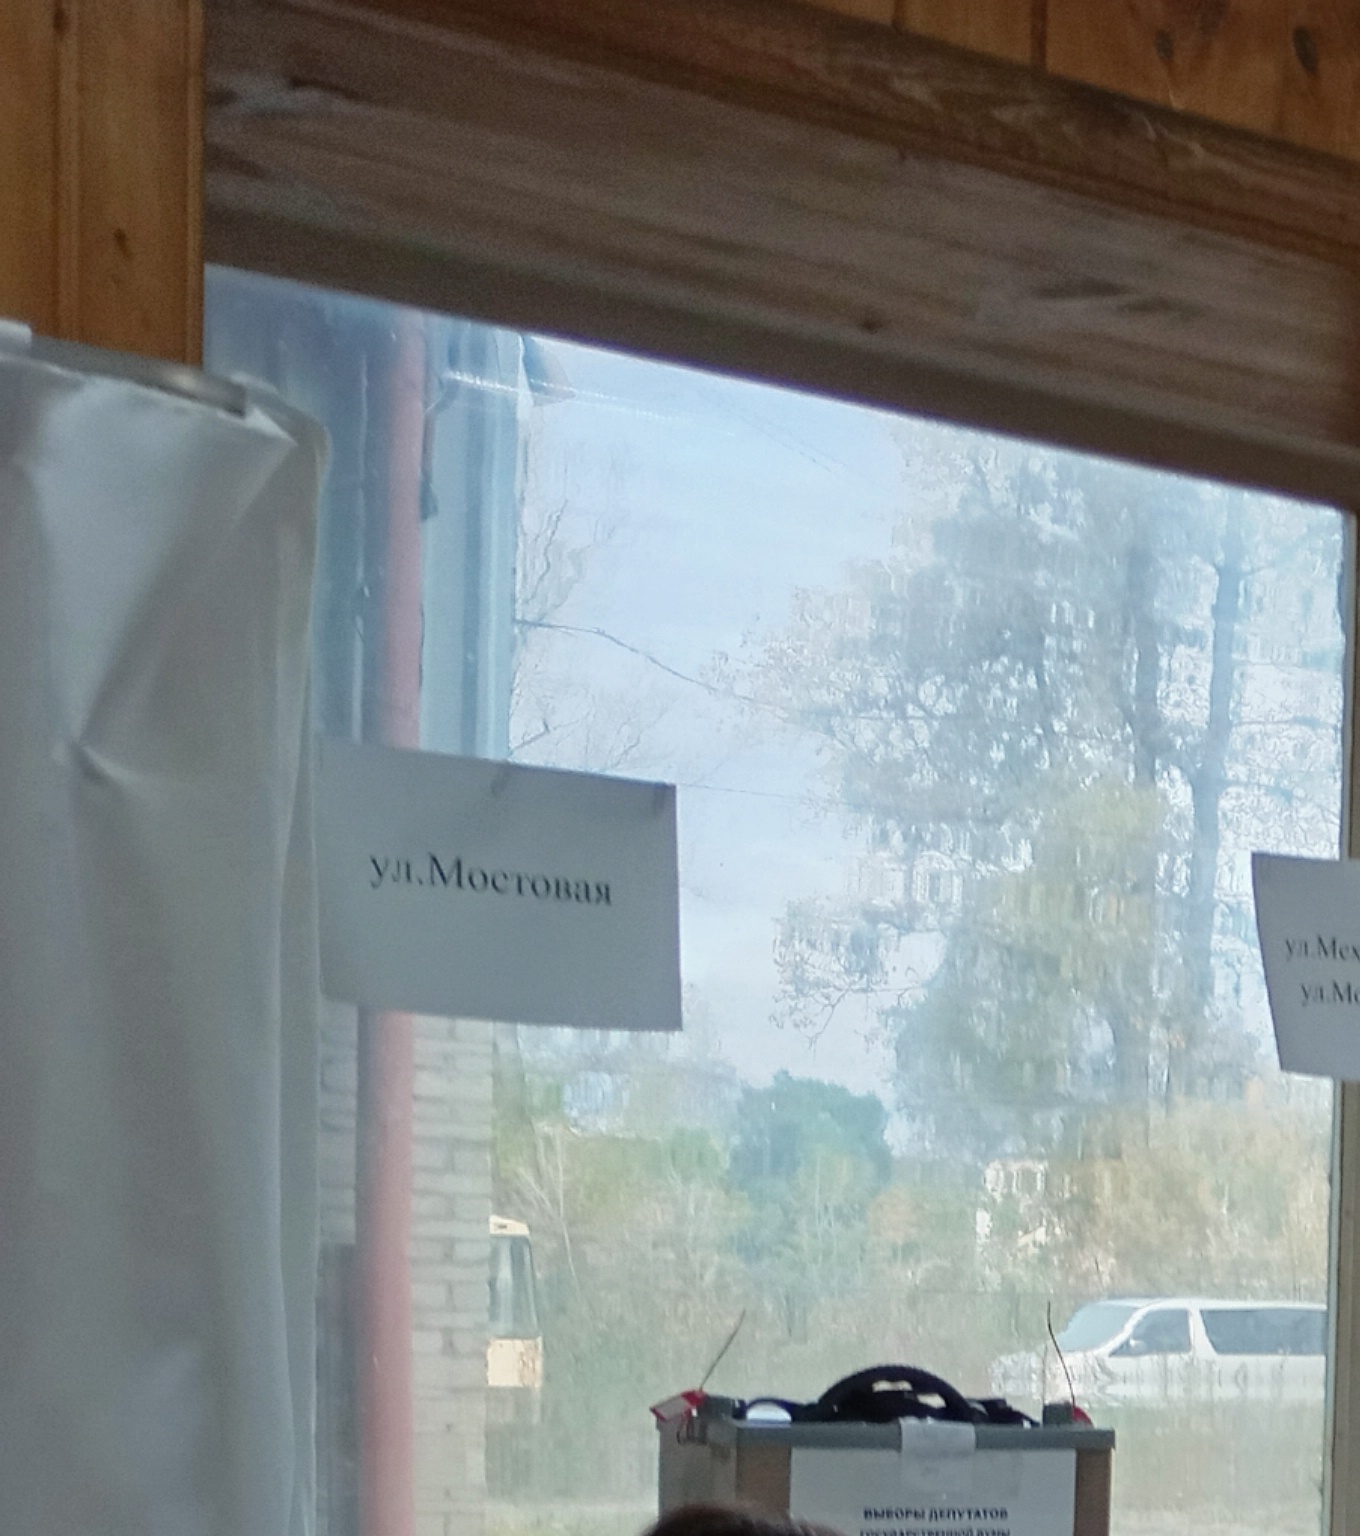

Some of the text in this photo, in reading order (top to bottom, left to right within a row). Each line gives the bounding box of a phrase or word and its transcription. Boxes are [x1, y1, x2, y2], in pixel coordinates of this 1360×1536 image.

[369, 851, 613, 906] ул.Мостовая
[863, 1507, 1009, 1522] ВЫБОРЫ ДЕПУТАТОВ
